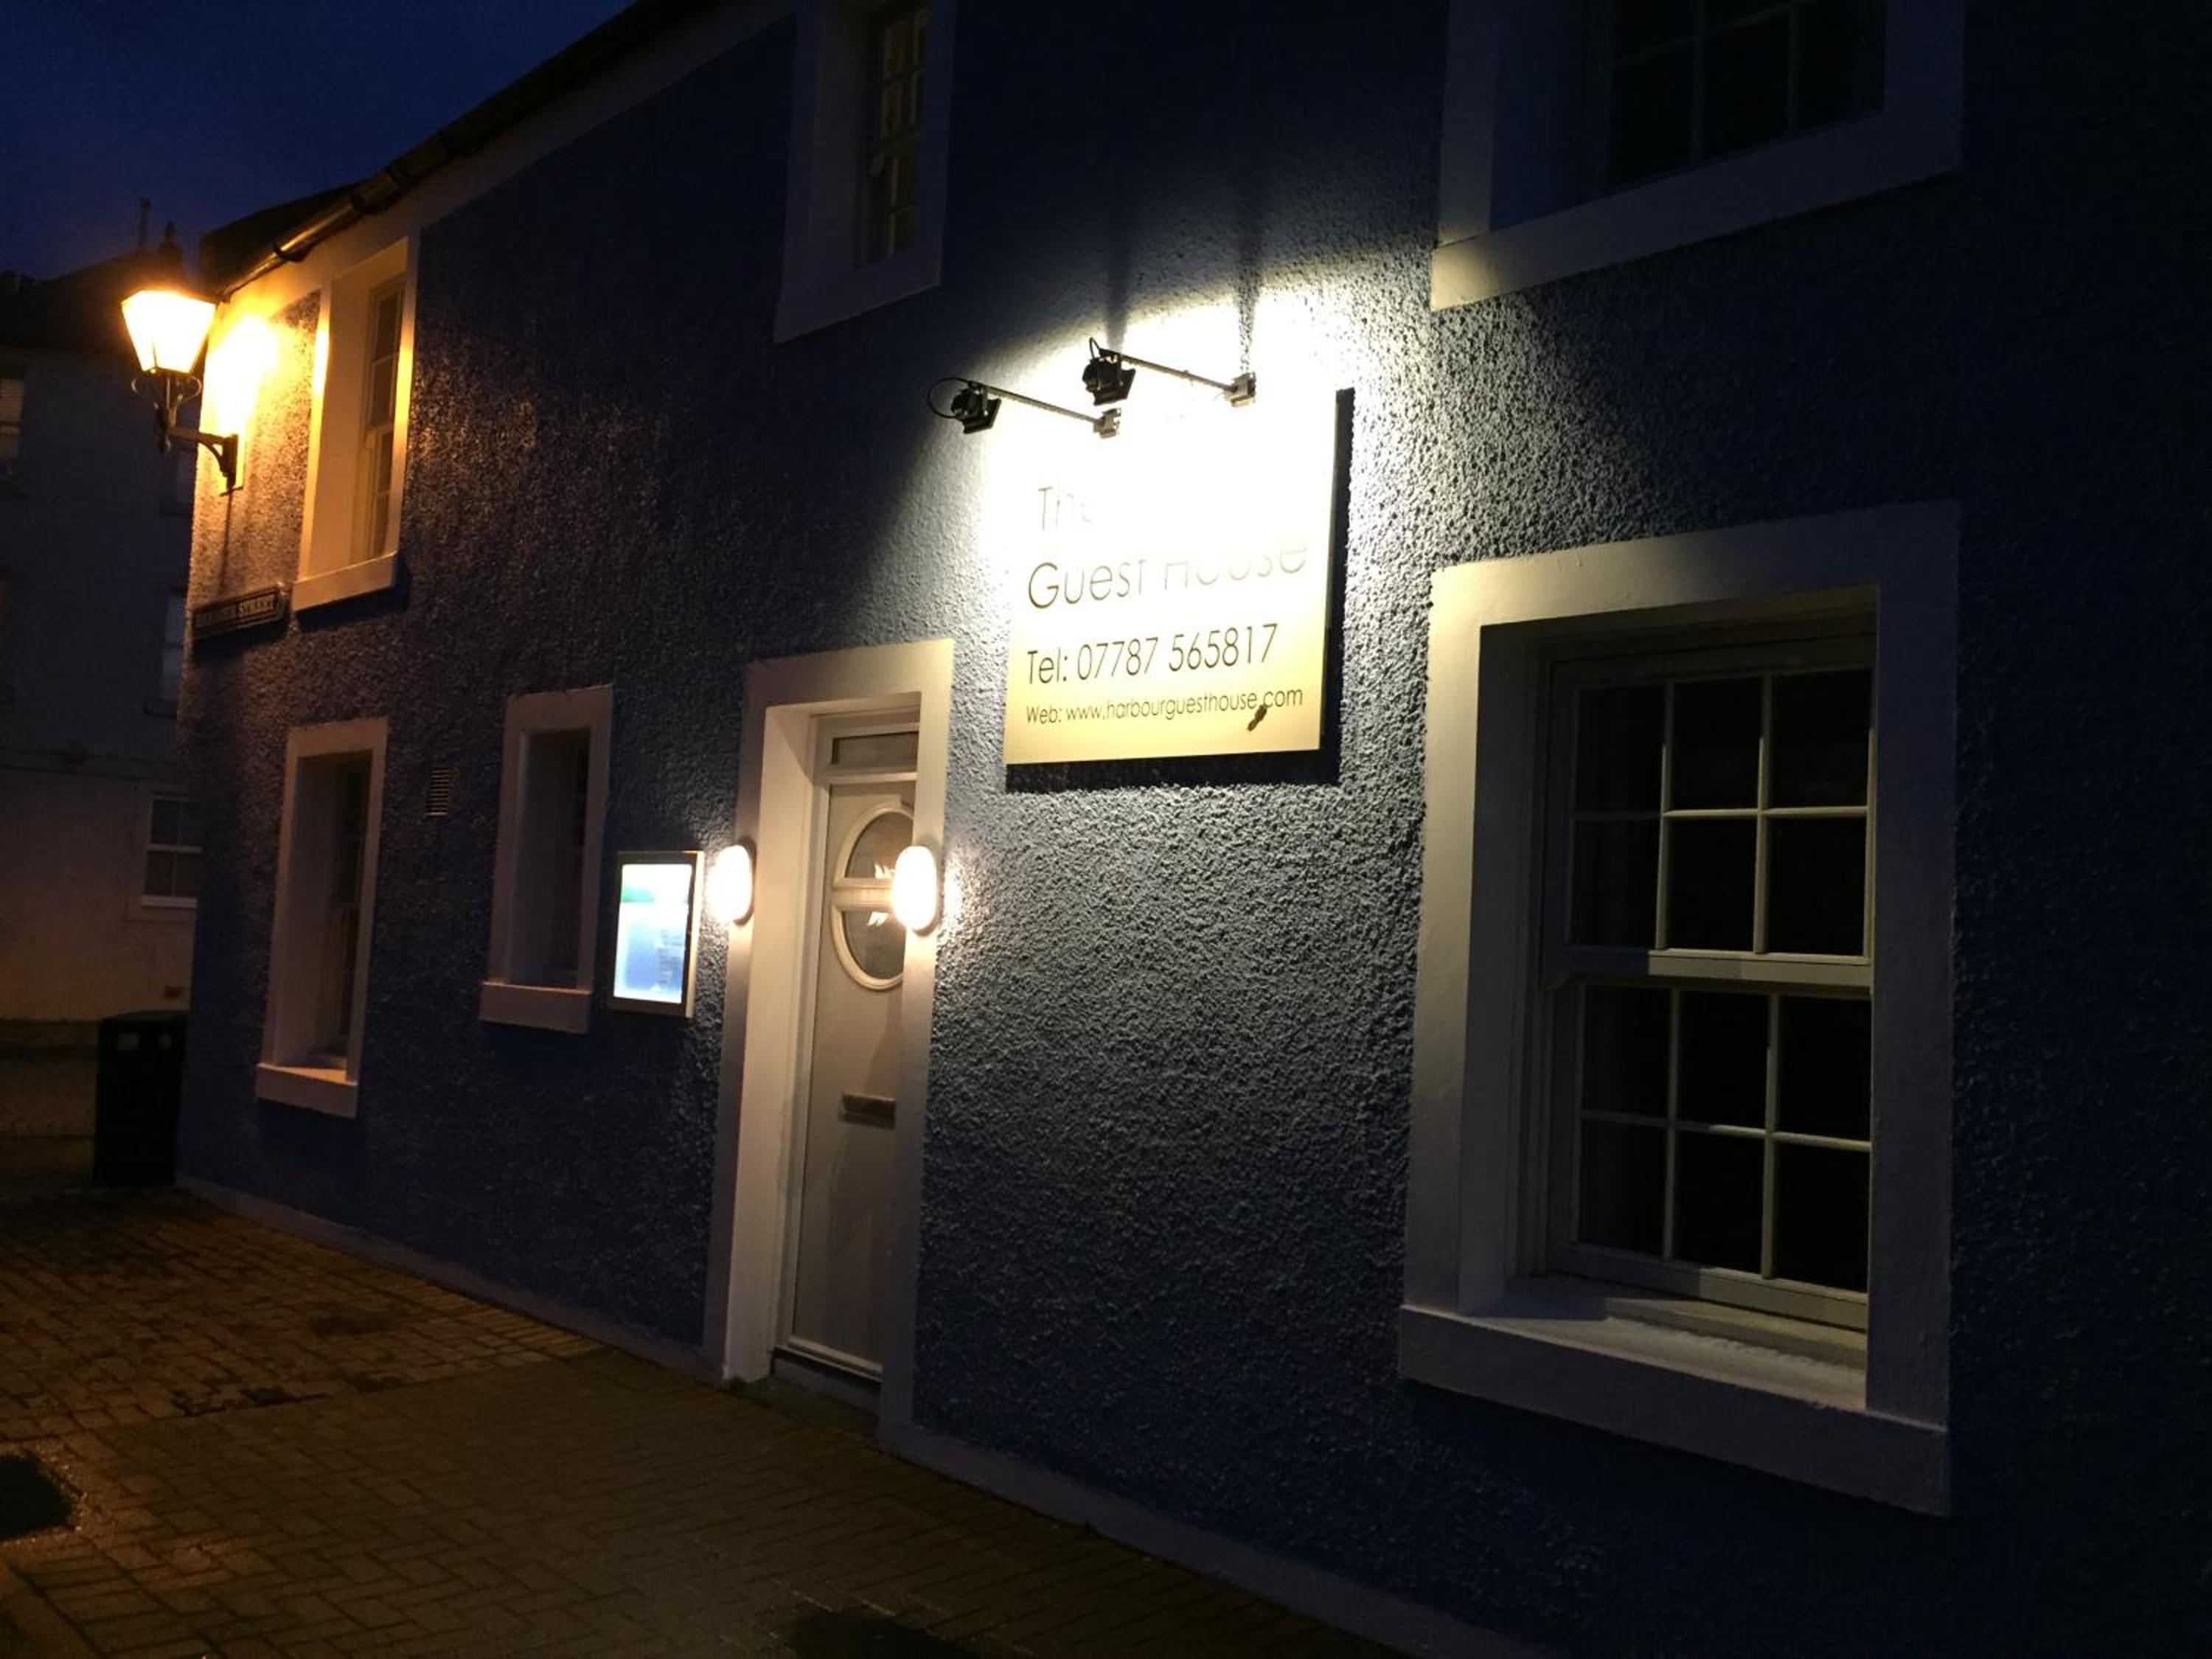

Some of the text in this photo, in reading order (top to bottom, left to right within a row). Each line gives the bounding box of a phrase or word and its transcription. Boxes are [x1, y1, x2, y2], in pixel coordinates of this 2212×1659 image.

[1028, 558, 1147, 609] Guest
[1027, 622, 1279, 685] Tel: 07787 565817
[1026, 689, 1304, 724] Web: www.harbourguesthouse.com
